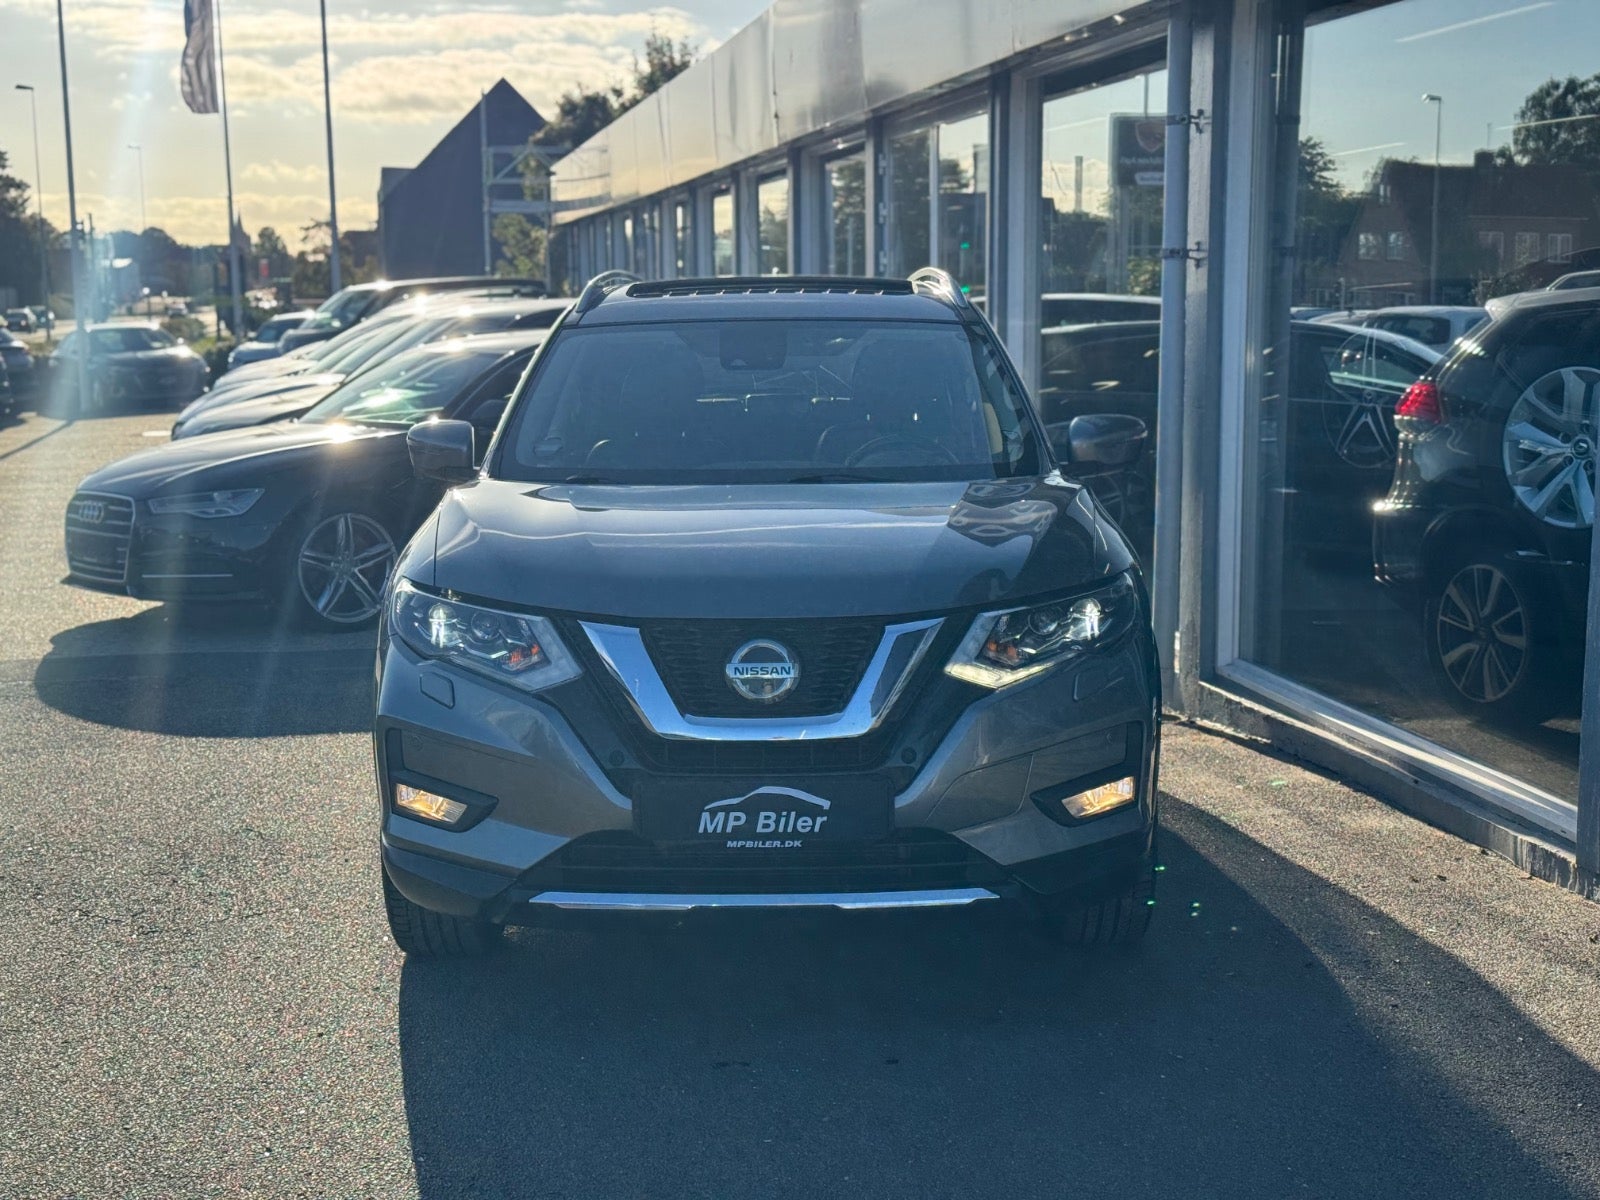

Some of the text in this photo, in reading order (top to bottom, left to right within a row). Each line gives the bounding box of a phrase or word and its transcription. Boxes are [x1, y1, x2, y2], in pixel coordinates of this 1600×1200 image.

[734, 666, 791, 676] NISSAN
[698, 811, 828, 833] MP Biler
[726, 840, 803, 848] MPBILER.DK
